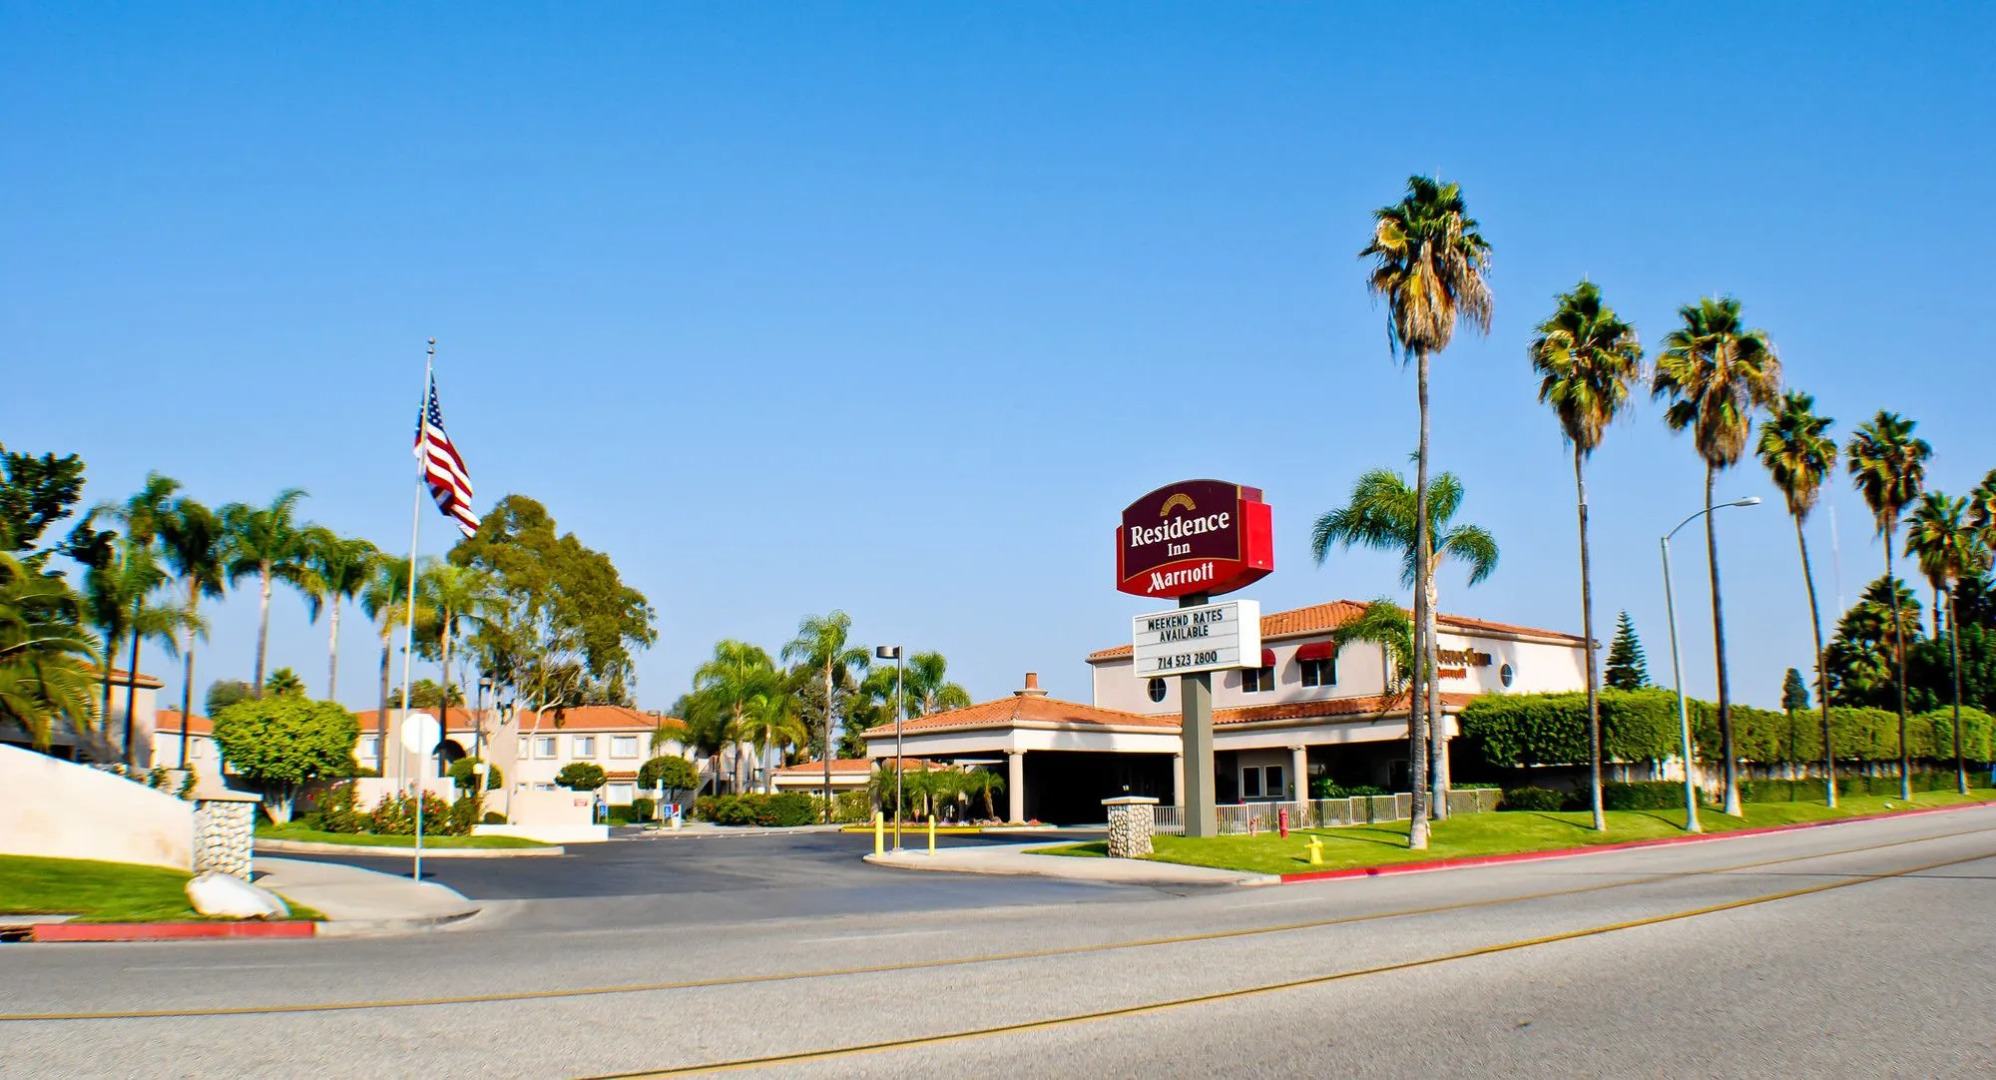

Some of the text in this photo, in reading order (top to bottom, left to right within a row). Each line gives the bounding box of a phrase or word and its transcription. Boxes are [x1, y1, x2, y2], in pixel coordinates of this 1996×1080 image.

[1130, 511, 1230, 547] Residence
[1168, 543, 1191, 557] Inn
[1147, 562, 1214, 593] Marriott
[1148, 609, 1223, 631] WEEKEND RATES
[1160, 625, 1209, 642] AVAILABLE
[1158, 651, 1218, 669] 714 523 2800
